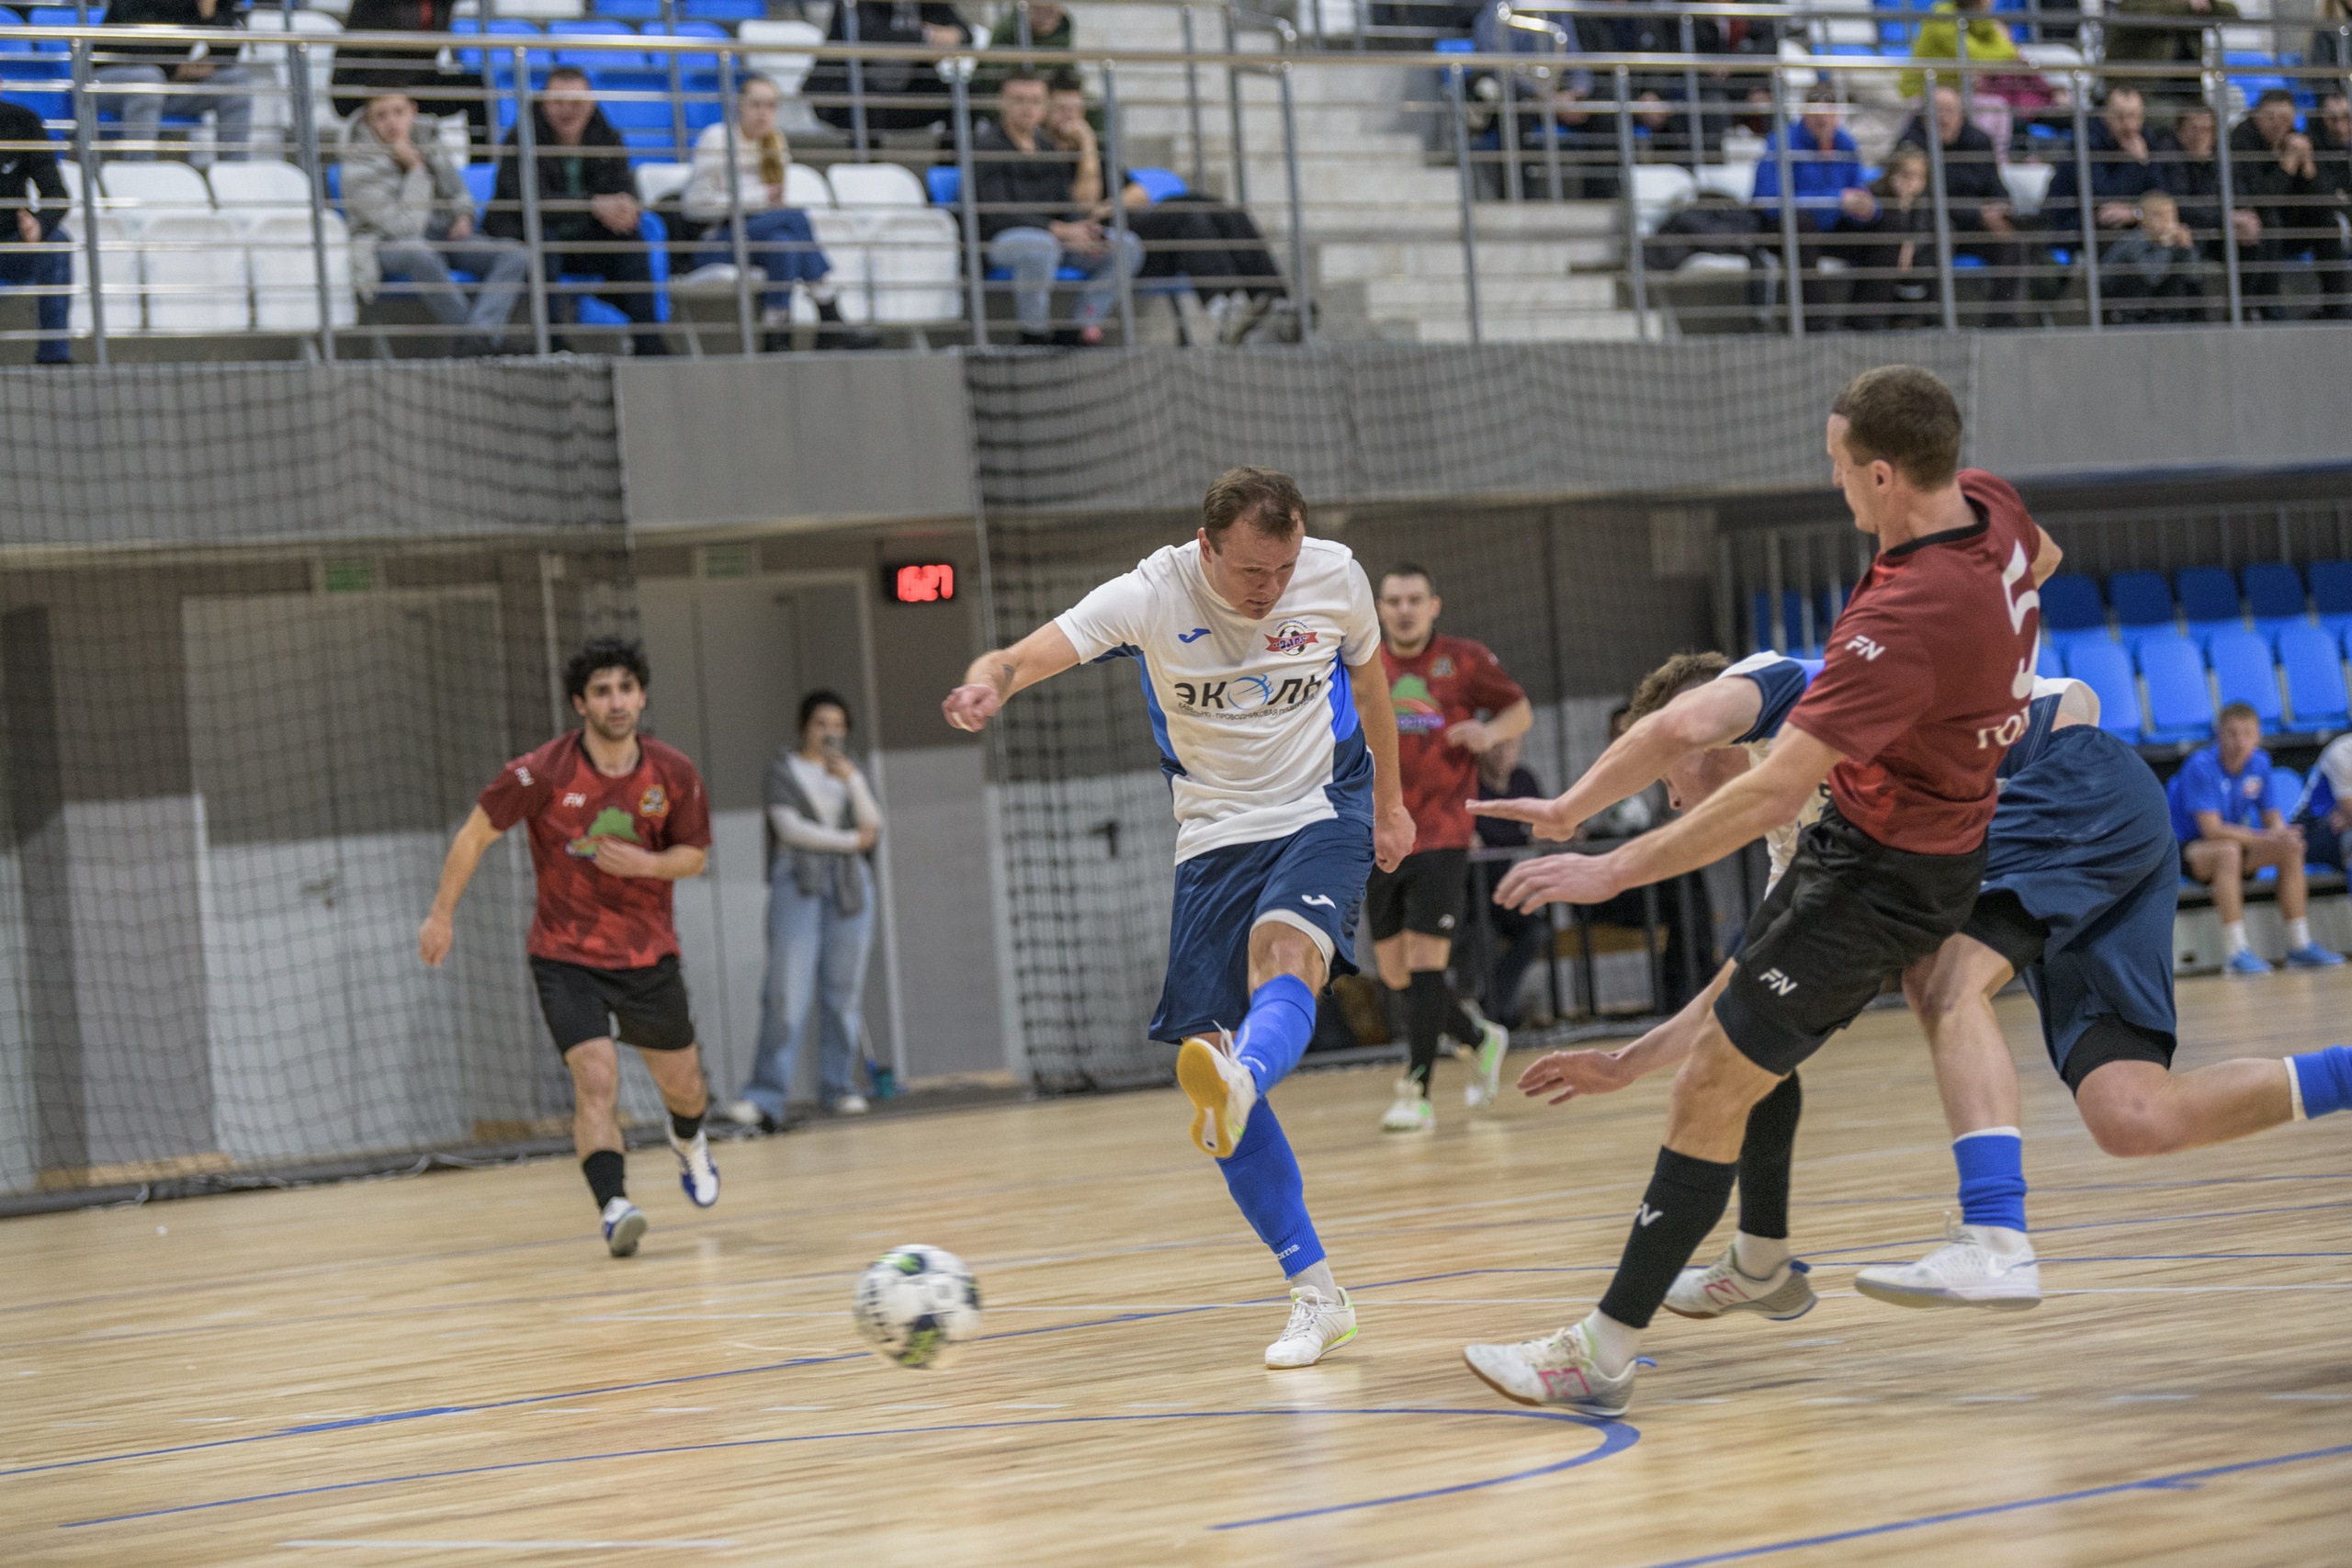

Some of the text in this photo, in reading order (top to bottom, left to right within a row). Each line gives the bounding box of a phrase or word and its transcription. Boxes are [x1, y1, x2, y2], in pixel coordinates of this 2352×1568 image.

[2002, 537, 2040, 700] 5
[1844, 635, 1885, 660] FN
[1758, 967, 1799, 997] FN
